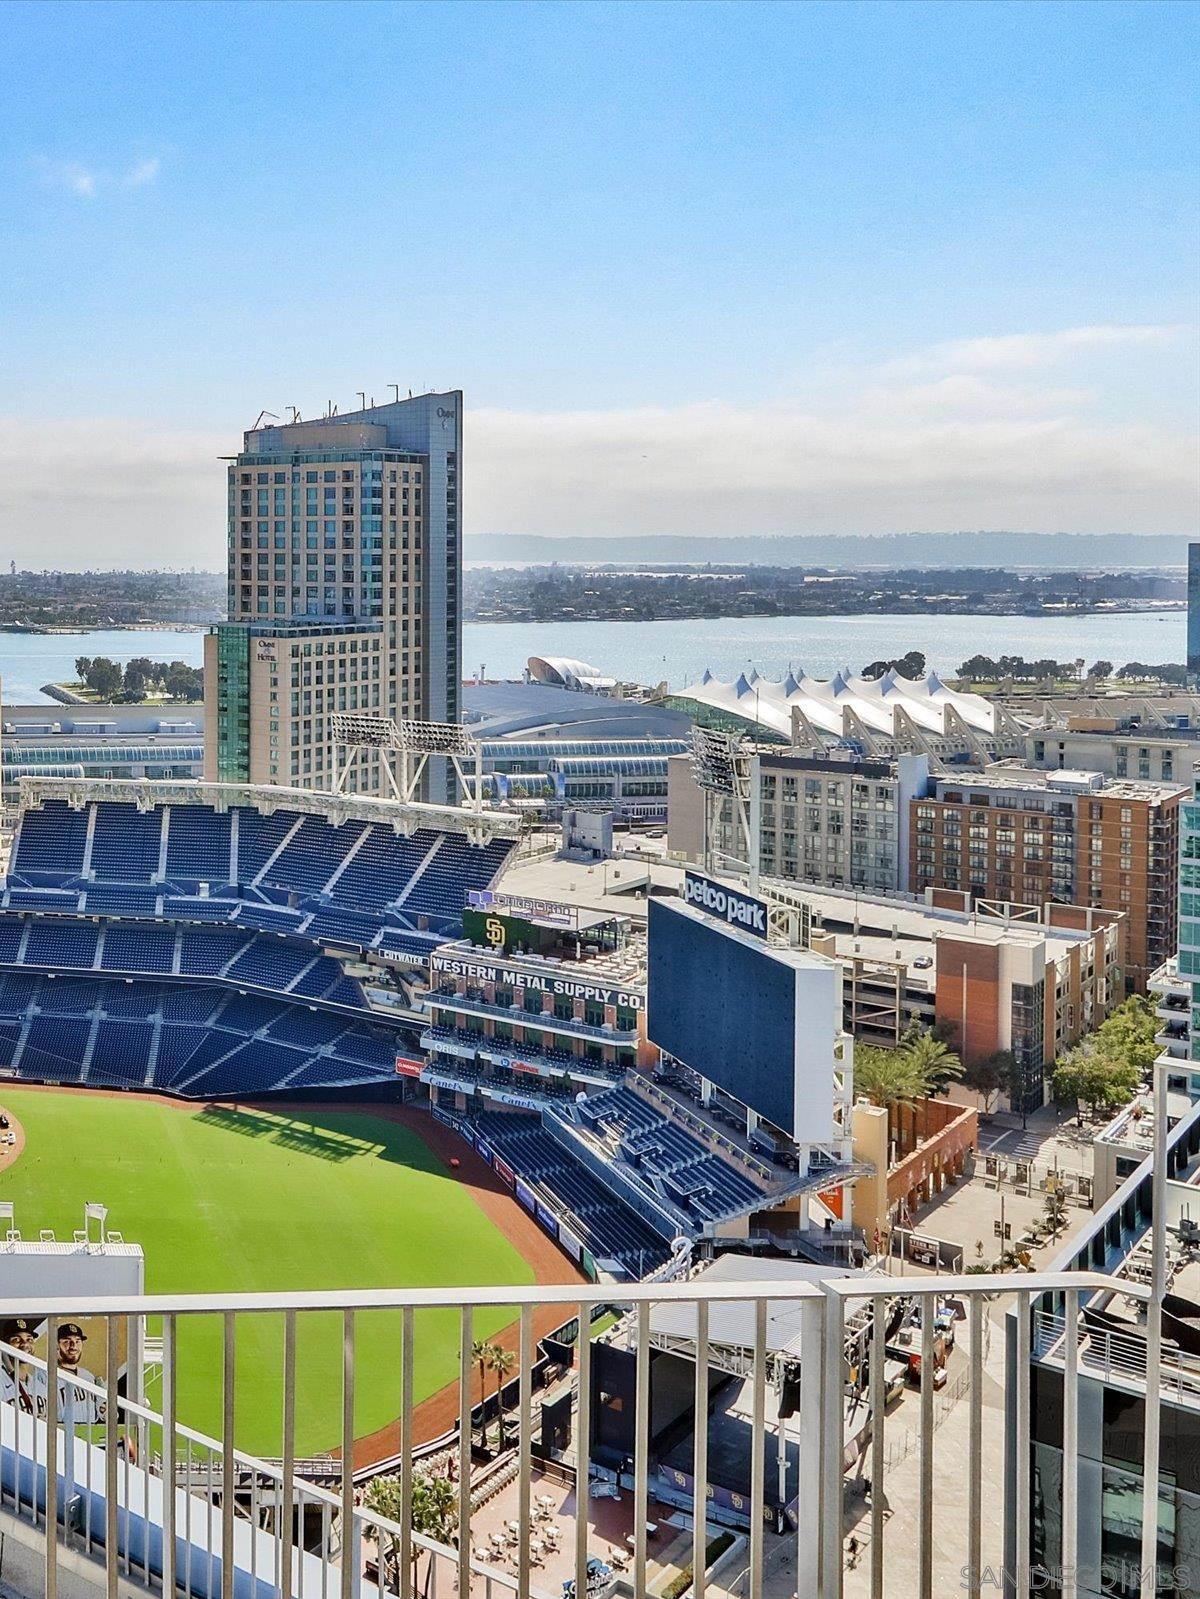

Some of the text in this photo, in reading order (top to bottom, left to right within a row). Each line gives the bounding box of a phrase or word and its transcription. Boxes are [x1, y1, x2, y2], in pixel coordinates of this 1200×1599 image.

[685, 878, 765, 930] petco park
[383, 950, 423, 965] CUTWATER
[432, 957, 645, 1010] WESTERN METAL SUPPLY CO.
